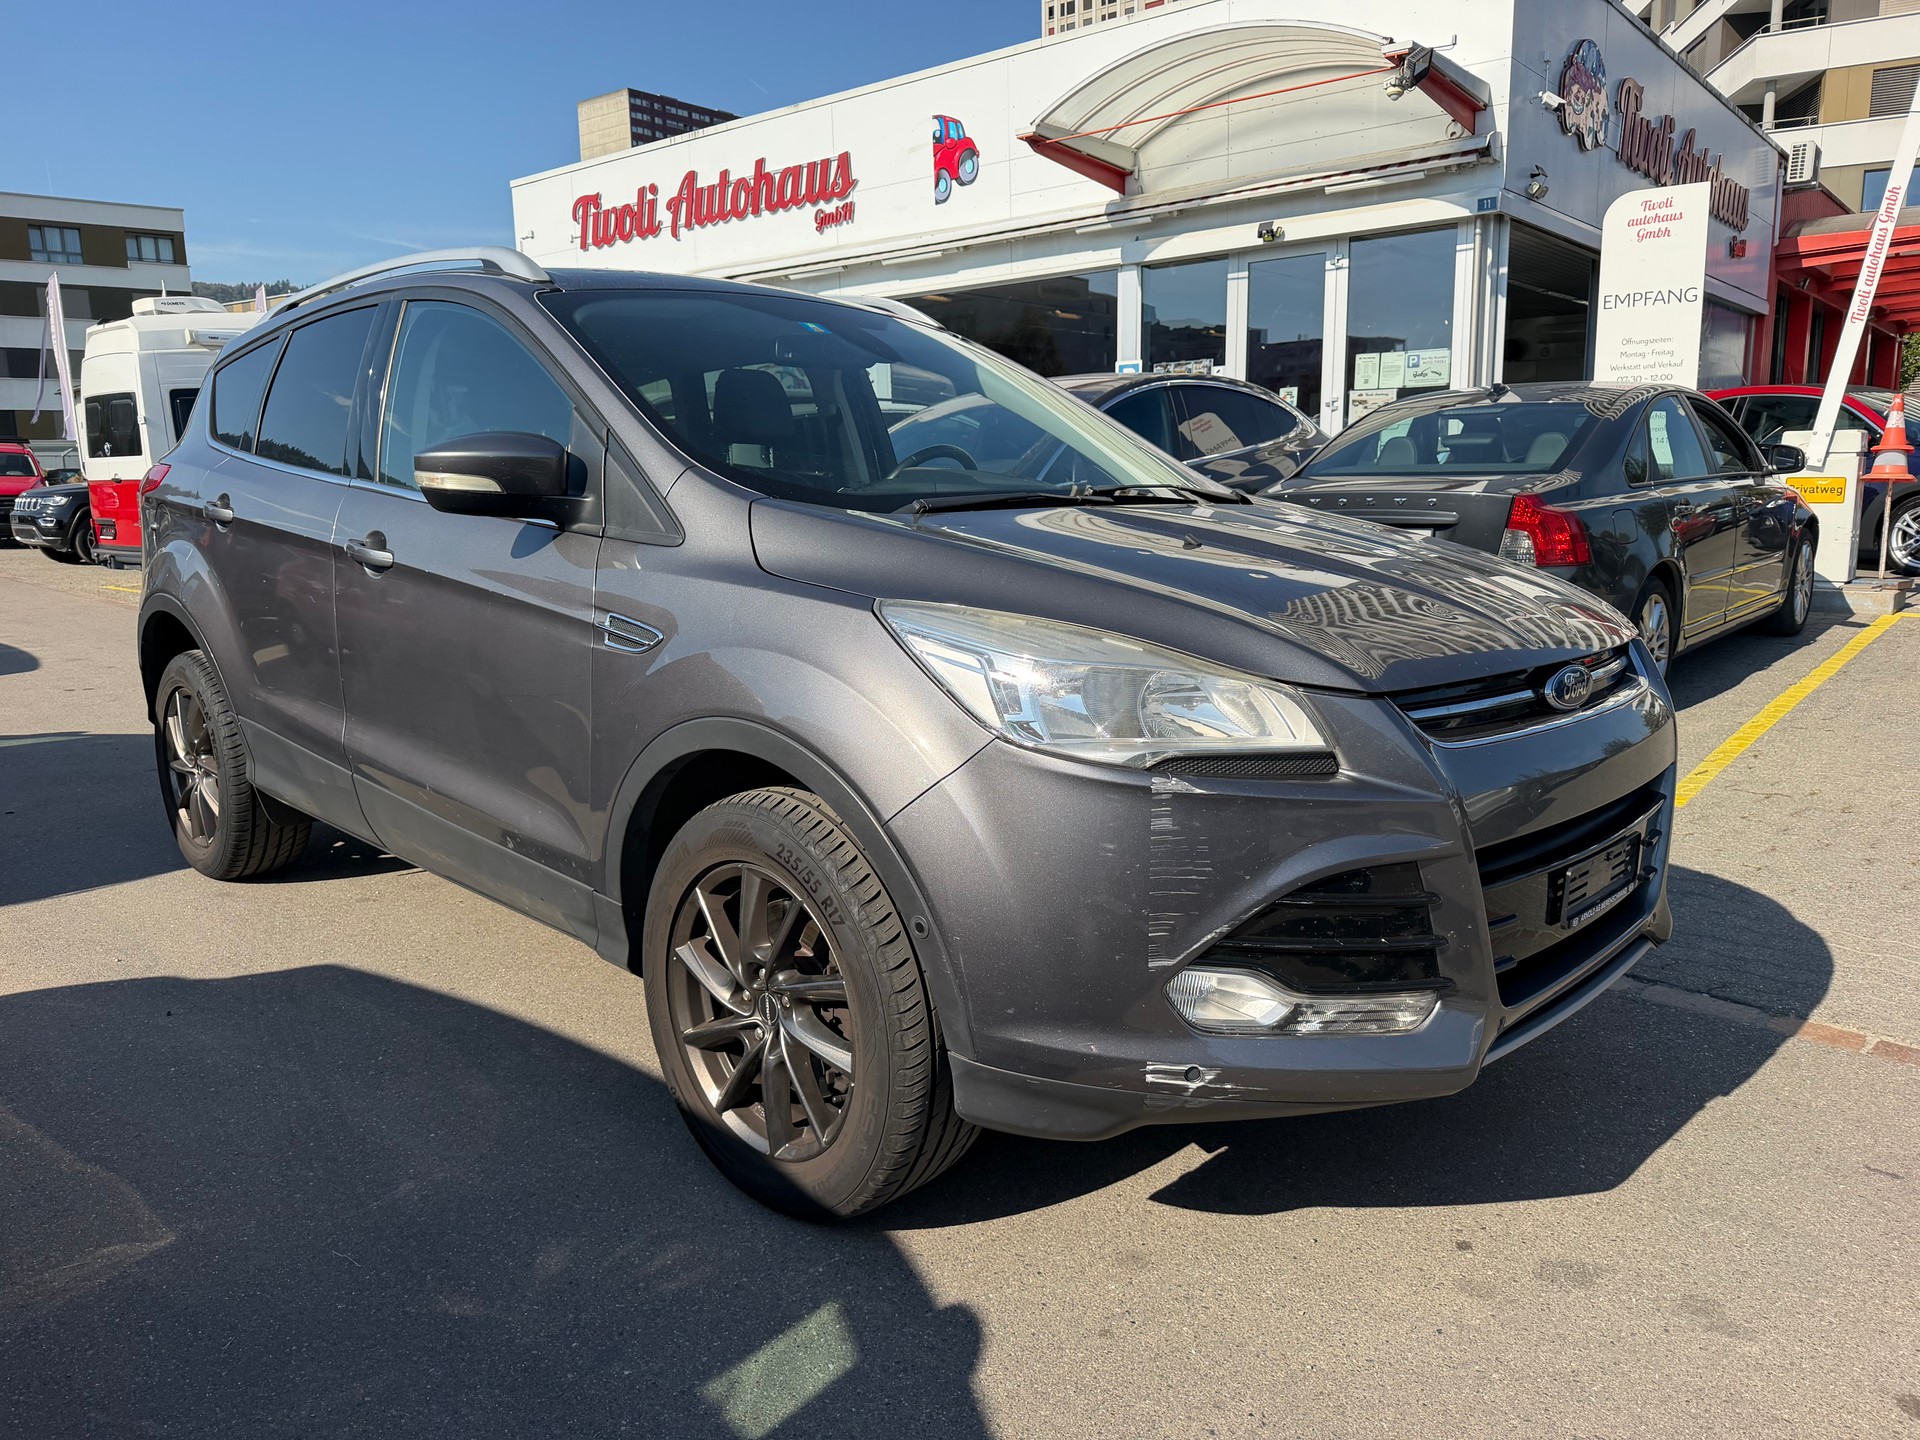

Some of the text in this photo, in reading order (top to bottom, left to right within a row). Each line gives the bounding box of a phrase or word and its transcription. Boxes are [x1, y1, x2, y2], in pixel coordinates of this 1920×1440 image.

[1618, 76, 1676, 187] Tivoli
[572, 150, 857, 251] Tivoli Autohaus
[1483, 199, 1491, 209] 11
[1640, 196, 1674, 212] Tivoli
[814, 200, 854, 233] GmbH
[1627, 211, 1684, 228] autohaus
[1636, 226, 1672, 243] Gmbh
[1850, 185, 1902, 324] Tivoli autohaus Gmbh
[1603, 286, 1698, 310] EMPFANG
[1610, 359, 1684, 372] Werkstatt und Verkauf
[1620, 350, 1646, 359] Montag
[1651, 348, 1674, 357] Freitag
[1564, 671, 1589, 700] Ford
[776, 843, 822, 894] 235/55
[821, 895, 847, 926] R17
